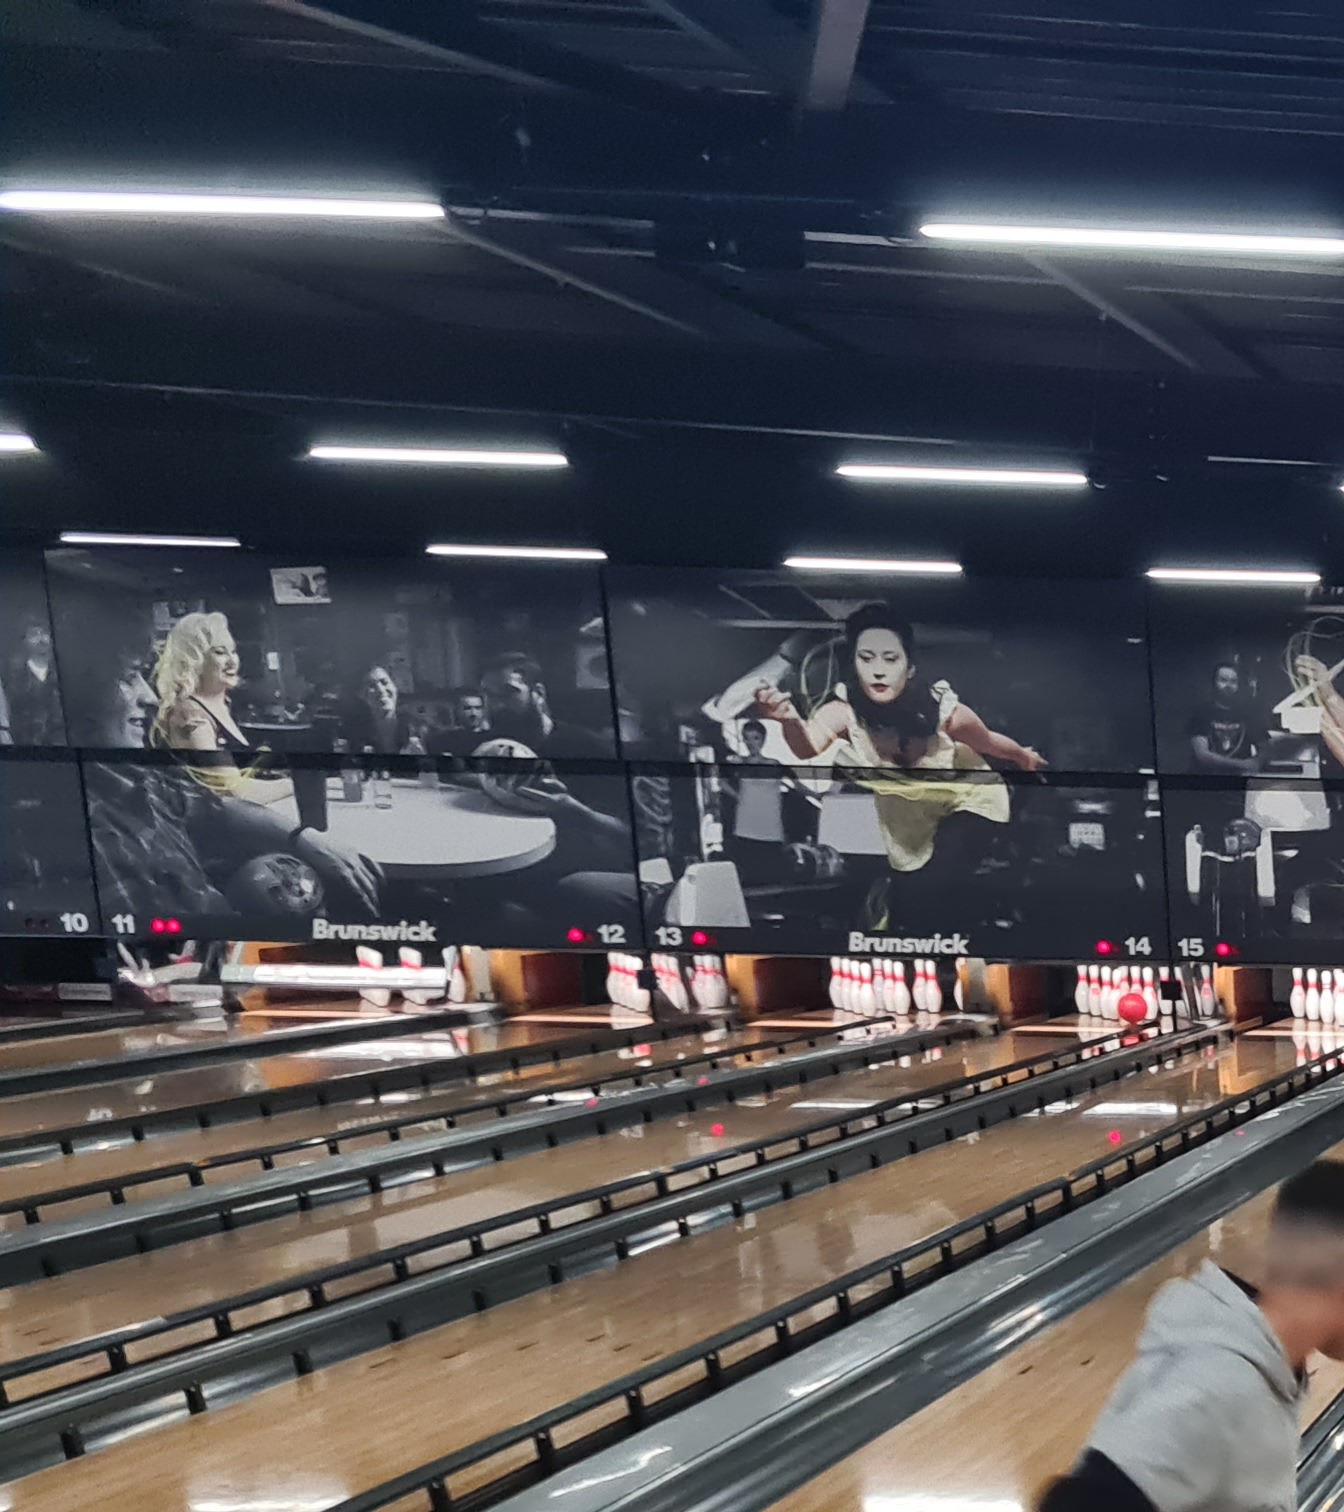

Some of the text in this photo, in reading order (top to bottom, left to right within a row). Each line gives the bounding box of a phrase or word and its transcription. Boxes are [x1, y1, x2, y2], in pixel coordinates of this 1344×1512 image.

[60, 912, 89, 932] 10
[111, 913, 136, 934] 11
[312, 918, 438, 942] Brunswick
[597, 923, 627, 944] 12
[655, 926, 683, 946] 13
[848, 931, 970, 955] Brunswick
[1124, 936, 1152, 956] 14
[1177, 937, 1205, 957] 15
